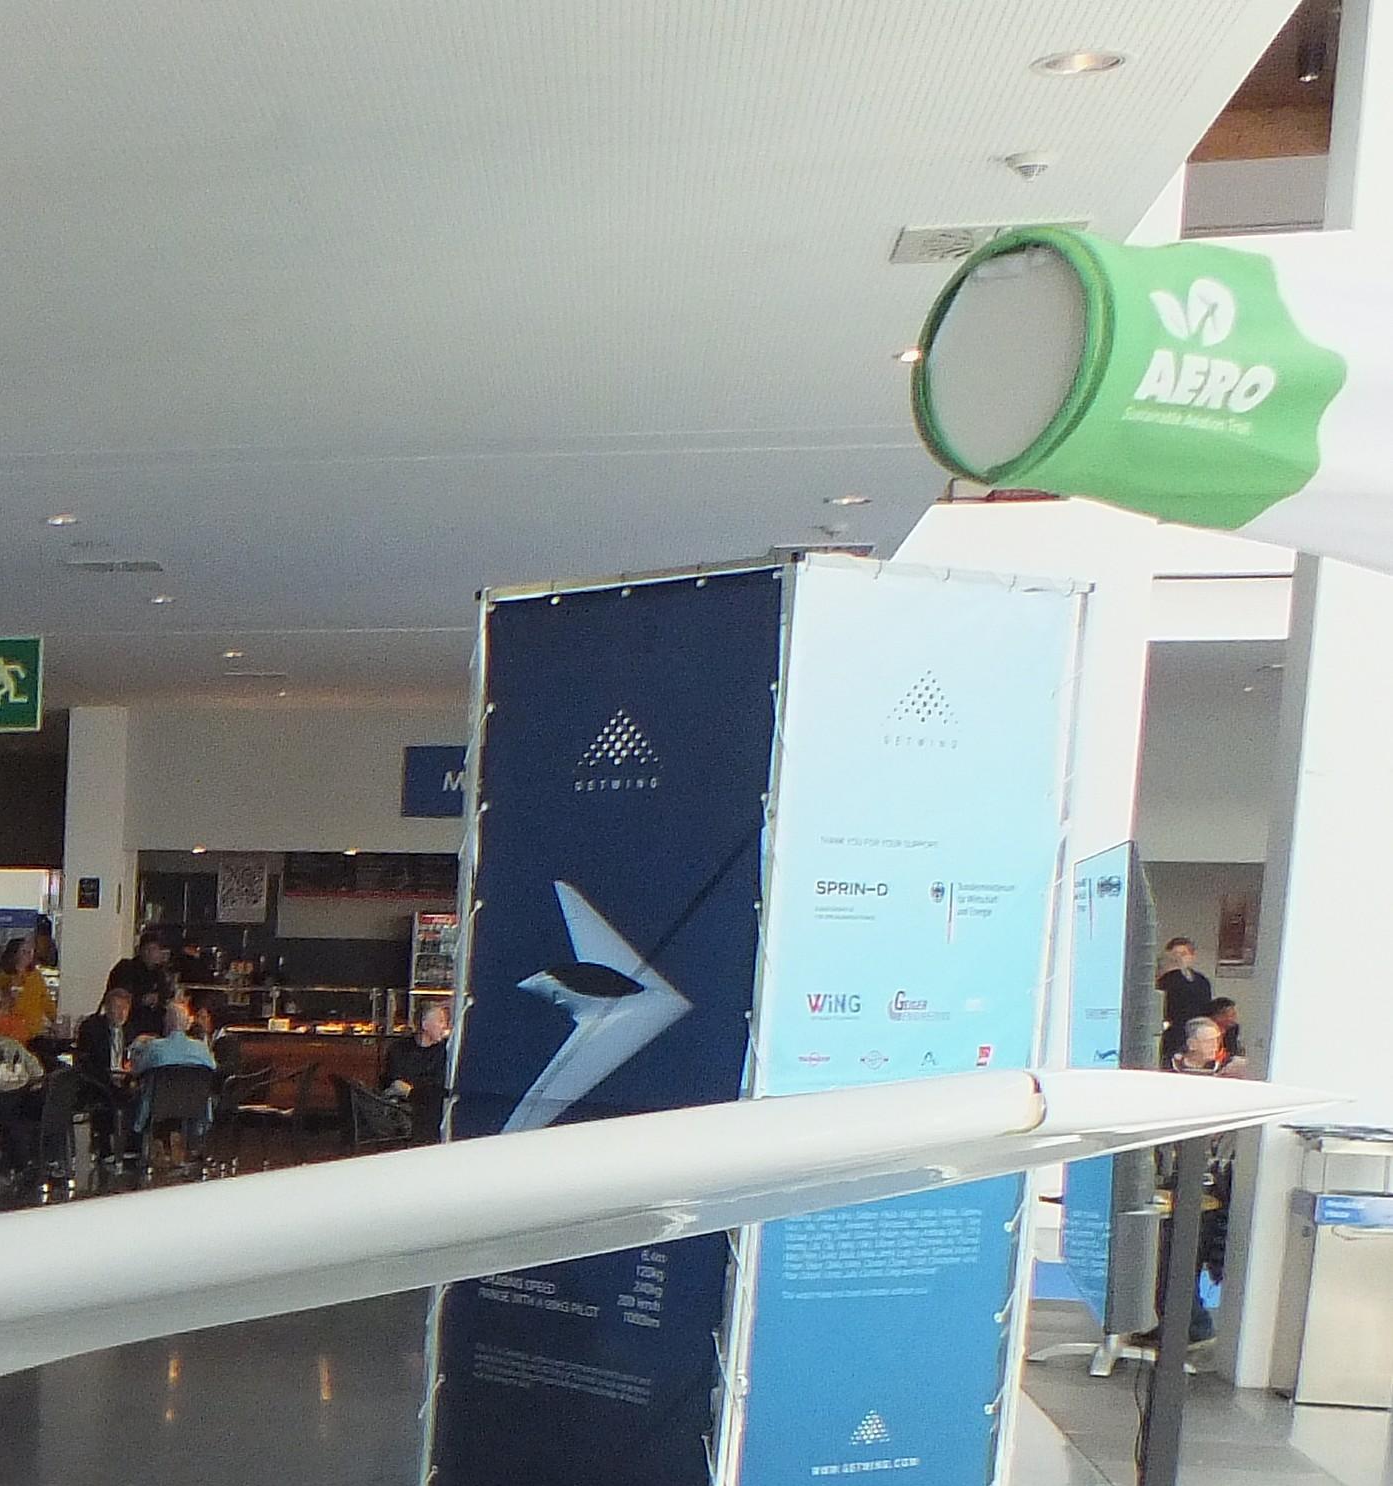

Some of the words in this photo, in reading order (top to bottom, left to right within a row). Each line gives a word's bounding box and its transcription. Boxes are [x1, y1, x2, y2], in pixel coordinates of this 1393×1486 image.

[1134, 349, 1277, 414] AERO
[883, 734, 959, 750] GETWING
[574, 777, 658, 792] GETWING
